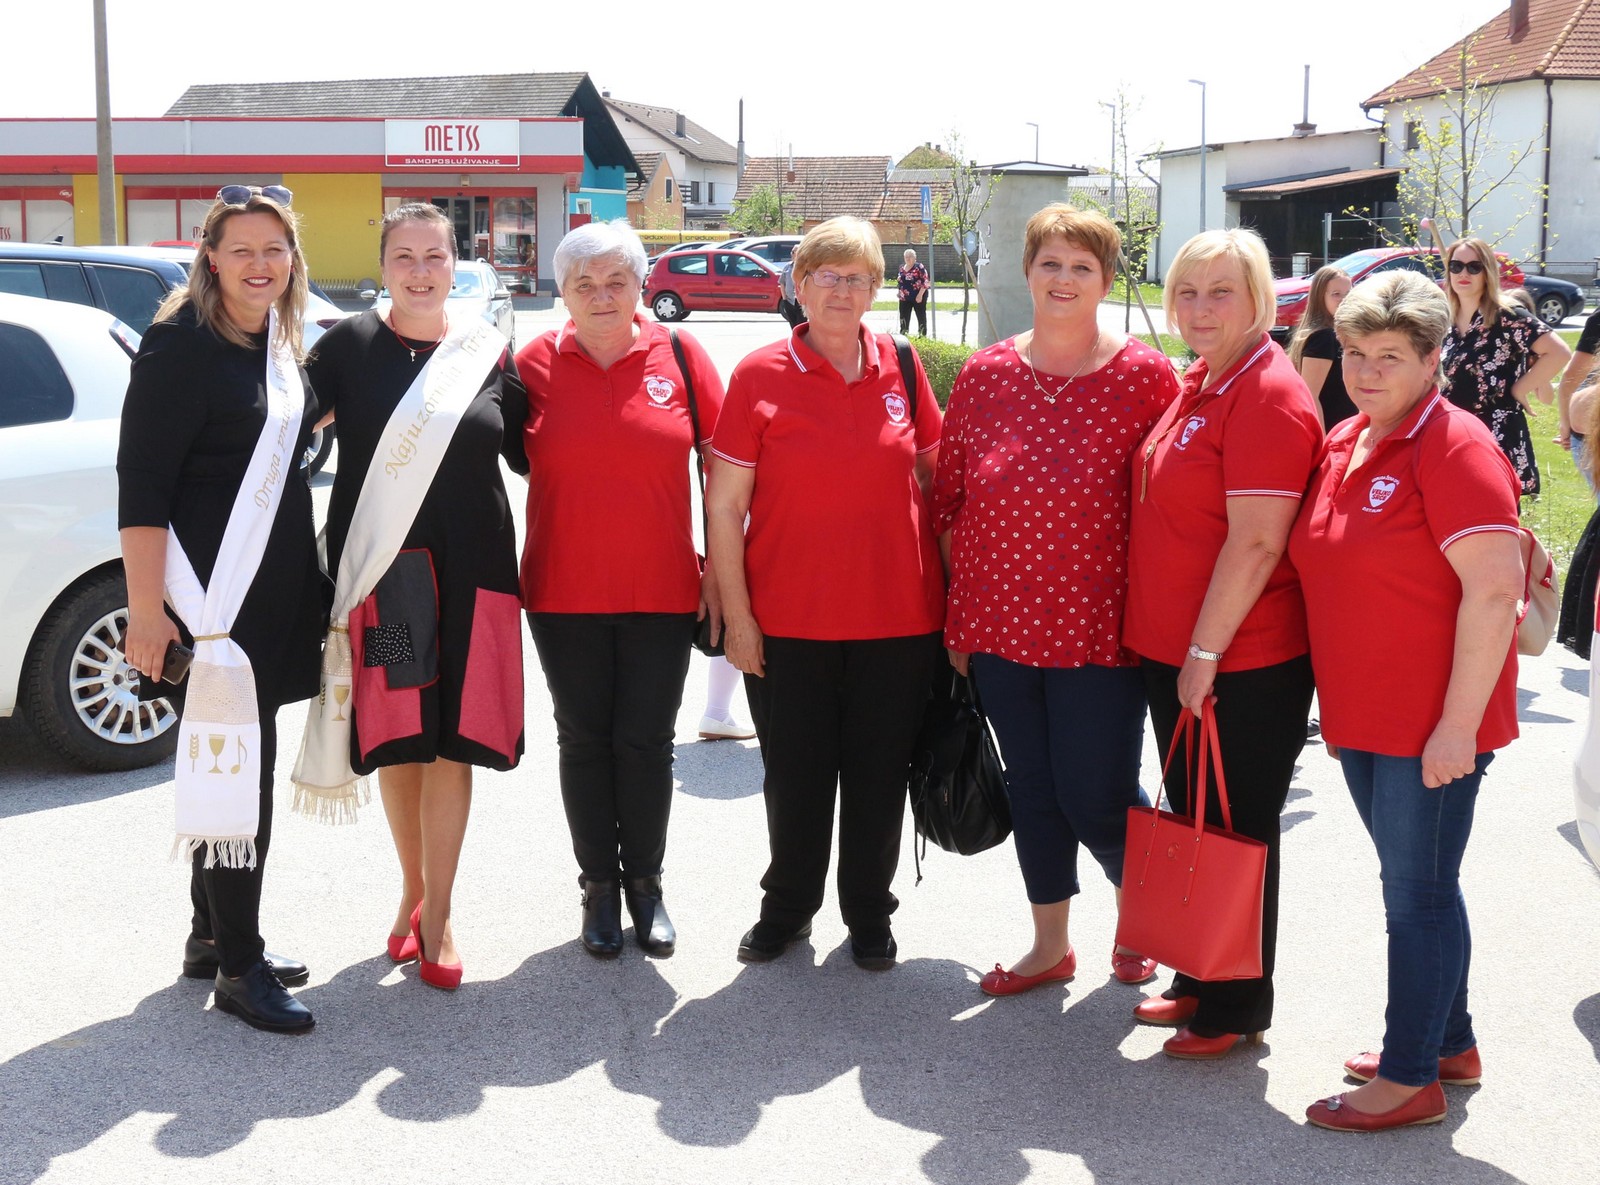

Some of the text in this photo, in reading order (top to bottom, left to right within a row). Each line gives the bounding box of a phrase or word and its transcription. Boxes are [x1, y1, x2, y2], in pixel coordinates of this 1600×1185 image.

[425, 125, 480, 151] METSS
[404, 157, 500, 165] SAMOPOSLUŽIVANJE
[254, 454, 281, 510] Druga
